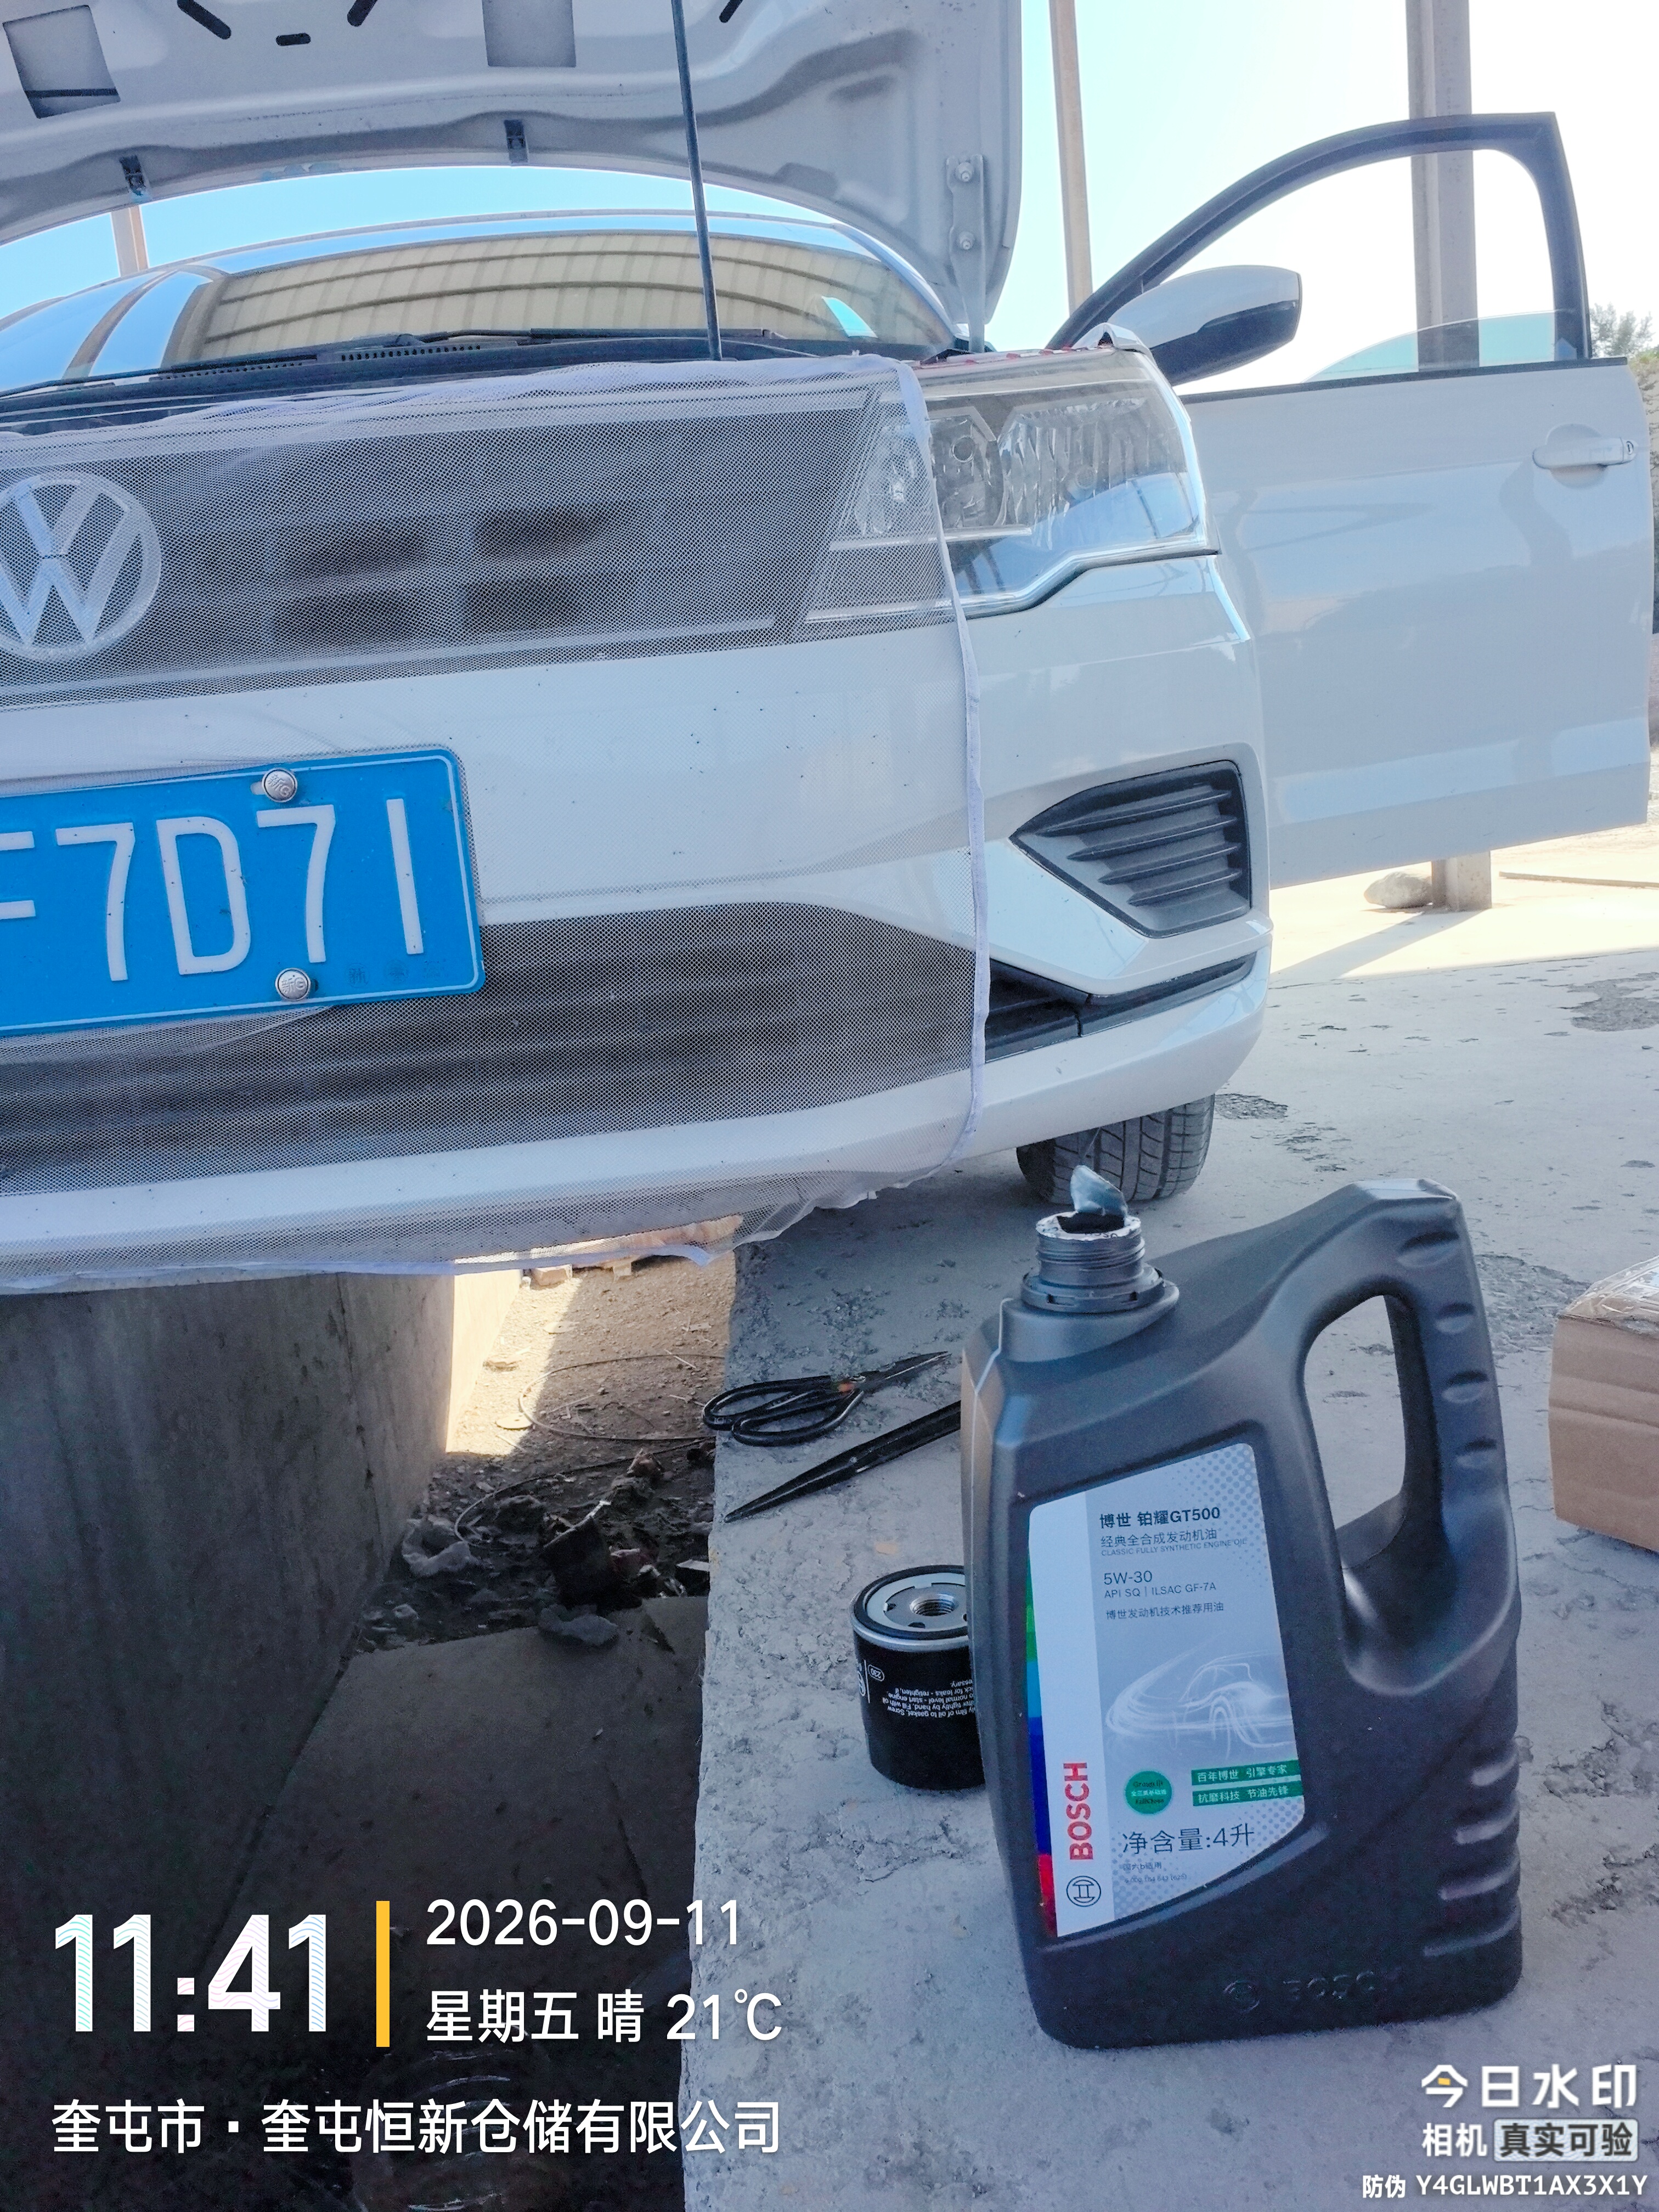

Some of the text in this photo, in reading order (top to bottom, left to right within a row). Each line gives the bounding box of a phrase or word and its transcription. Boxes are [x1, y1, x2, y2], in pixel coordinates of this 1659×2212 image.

[1099, 1507, 1221, 1529] 博世 铂耀GT500
[1101, 1528, 1217, 1548] 经典全合成发动机油
[1101, 1548, 1134, 1556] CLASSIC
[1136, 1546, 1159, 1554] FULLY
[1160, 1543, 1201, 1553] SYNTHETIC
[1204, 1540, 1232, 1549] ENGINE
[1103, 1570, 1153, 1585] 5W-30
[1104, 1589, 1121, 1599] API
[1125, 1588, 1141, 1598] SQ
[1152, 1584, 1181, 1595] ILSAC
[1185, 1582, 1217, 1593] GF-7A
[1106, 1601, 1224, 1620] 博世发动机技术推荐用油
[950, 1679, 973, 1688] essary.
[1197, 1764, 1288, 1783] 百年博世 引擎专家
[1063, 1762, 1093, 1860] BOSCH
[1122, 1822, 1255, 1854] 净含量:4升
